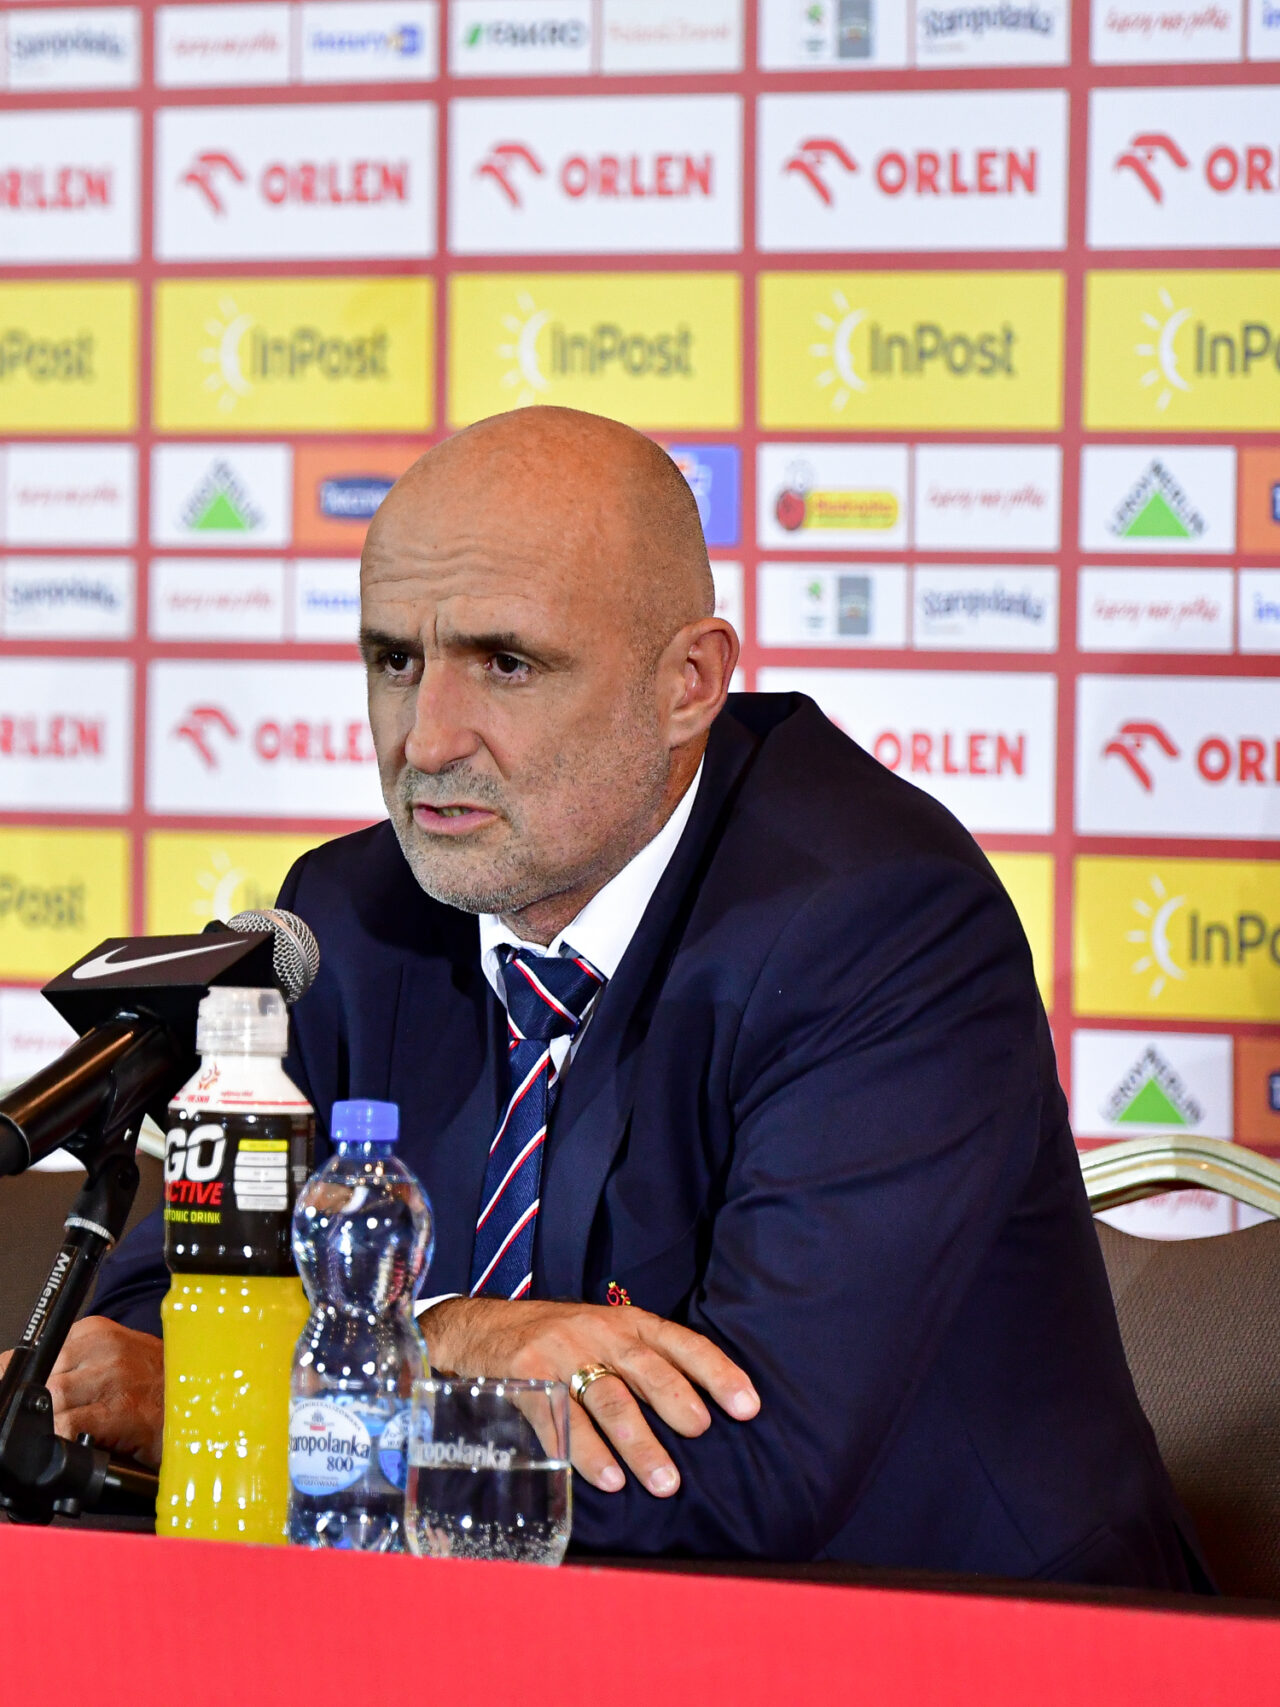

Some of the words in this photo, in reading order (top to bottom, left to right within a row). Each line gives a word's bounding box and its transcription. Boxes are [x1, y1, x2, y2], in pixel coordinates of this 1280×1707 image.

[261, 161, 409, 205] ORLEN
[561, 155, 714, 198] ORLEN
[875, 150, 1038, 197] ORLEN
[1204, 146, 1280, 193] OR
[257, 327, 390, 379] InPost
[555, 322, 694, 377] InPost
[869, 322, 1016, 377] InPost
[256, 720, 378, 763] ORLE
[873, 732, 1027, 776] ORLEN
[1196, 738, 1280, 784] OR
[164, 1123, 227, 1182] GO
[191, 1210, 221, 1224] DRINK
[23, 1252, 70, 1341] Millenium
[326, 1456, 354, 1472] 800
